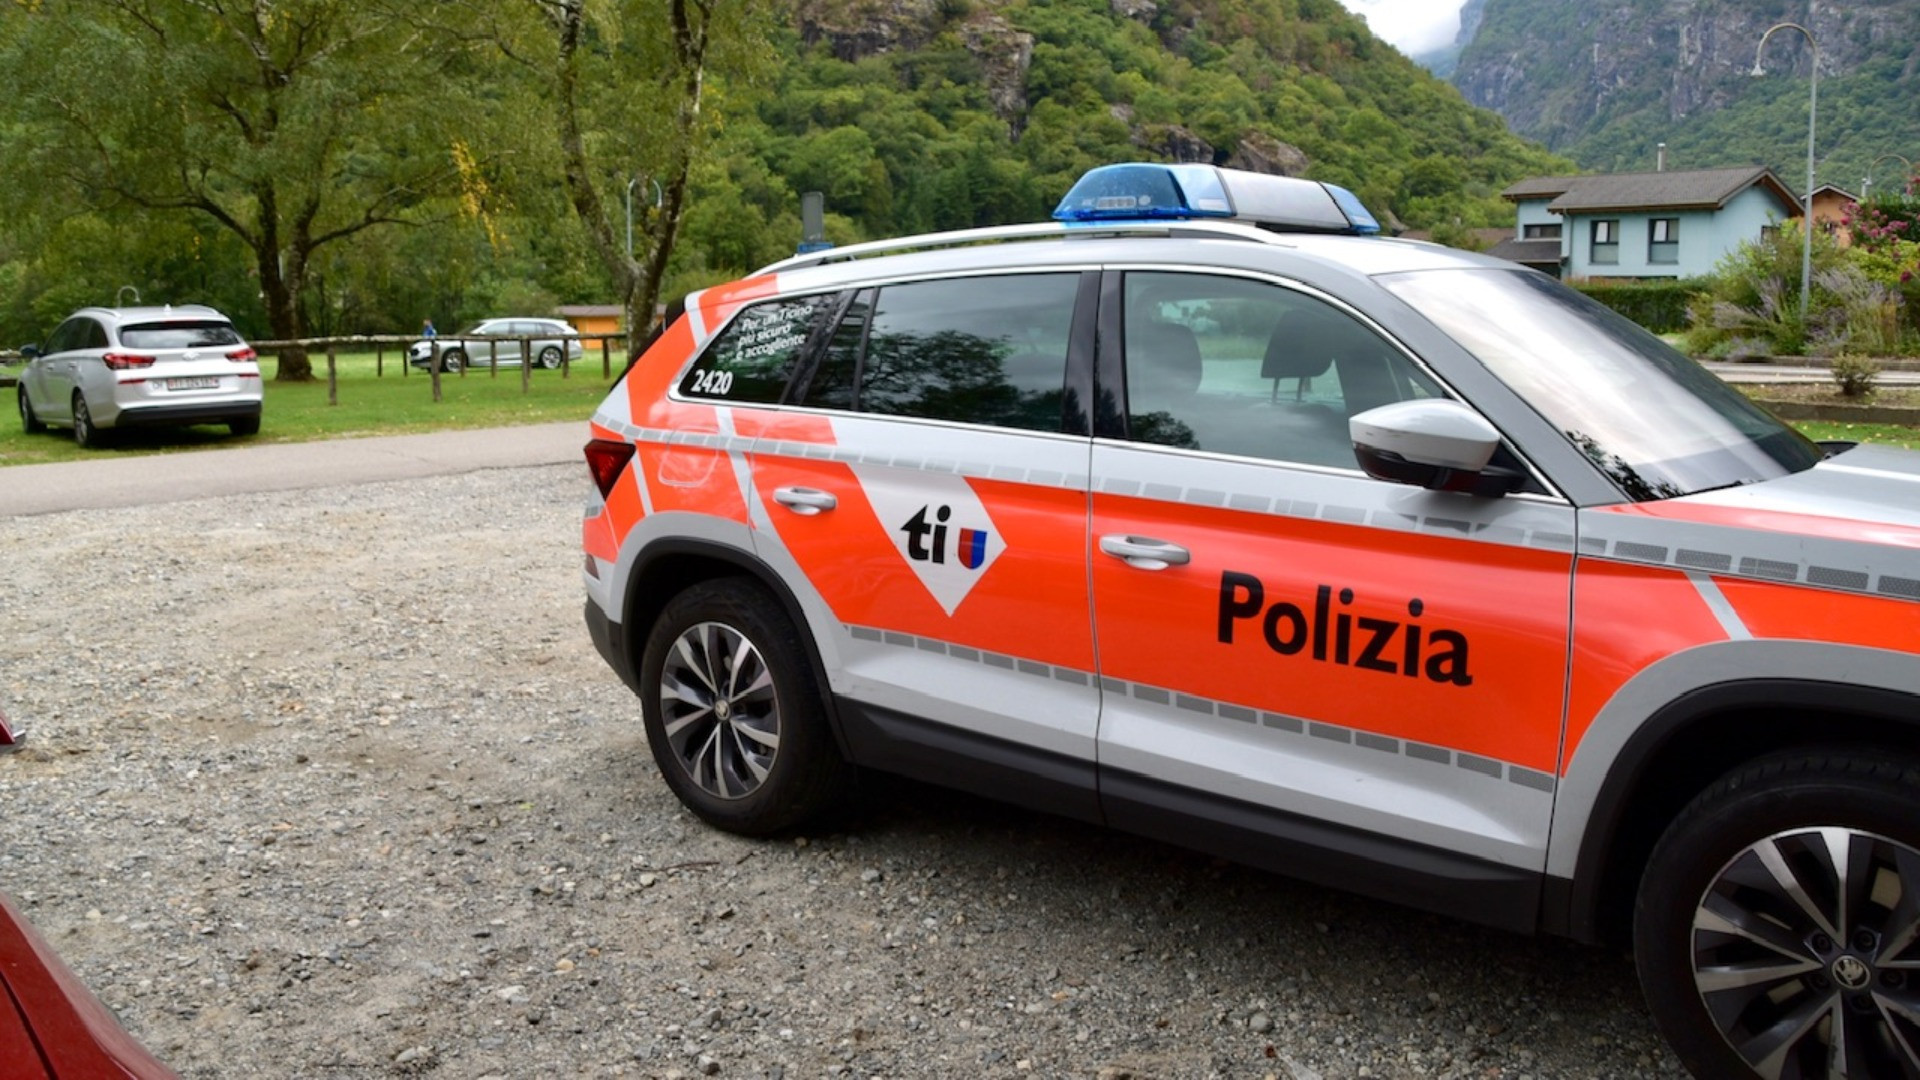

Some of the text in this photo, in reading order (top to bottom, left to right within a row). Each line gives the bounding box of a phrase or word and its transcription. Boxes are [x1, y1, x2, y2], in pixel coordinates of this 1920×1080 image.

[742, 305, 813, 331] Per un Ticino
[757, 324, 791, 341] sicuro
[736, 334, 807, 361] e accogliente
[690, 369, 734, 395] 2420
[900, 504, 951, 564] ti
[1218, 570, 1473, 687] Polizia
